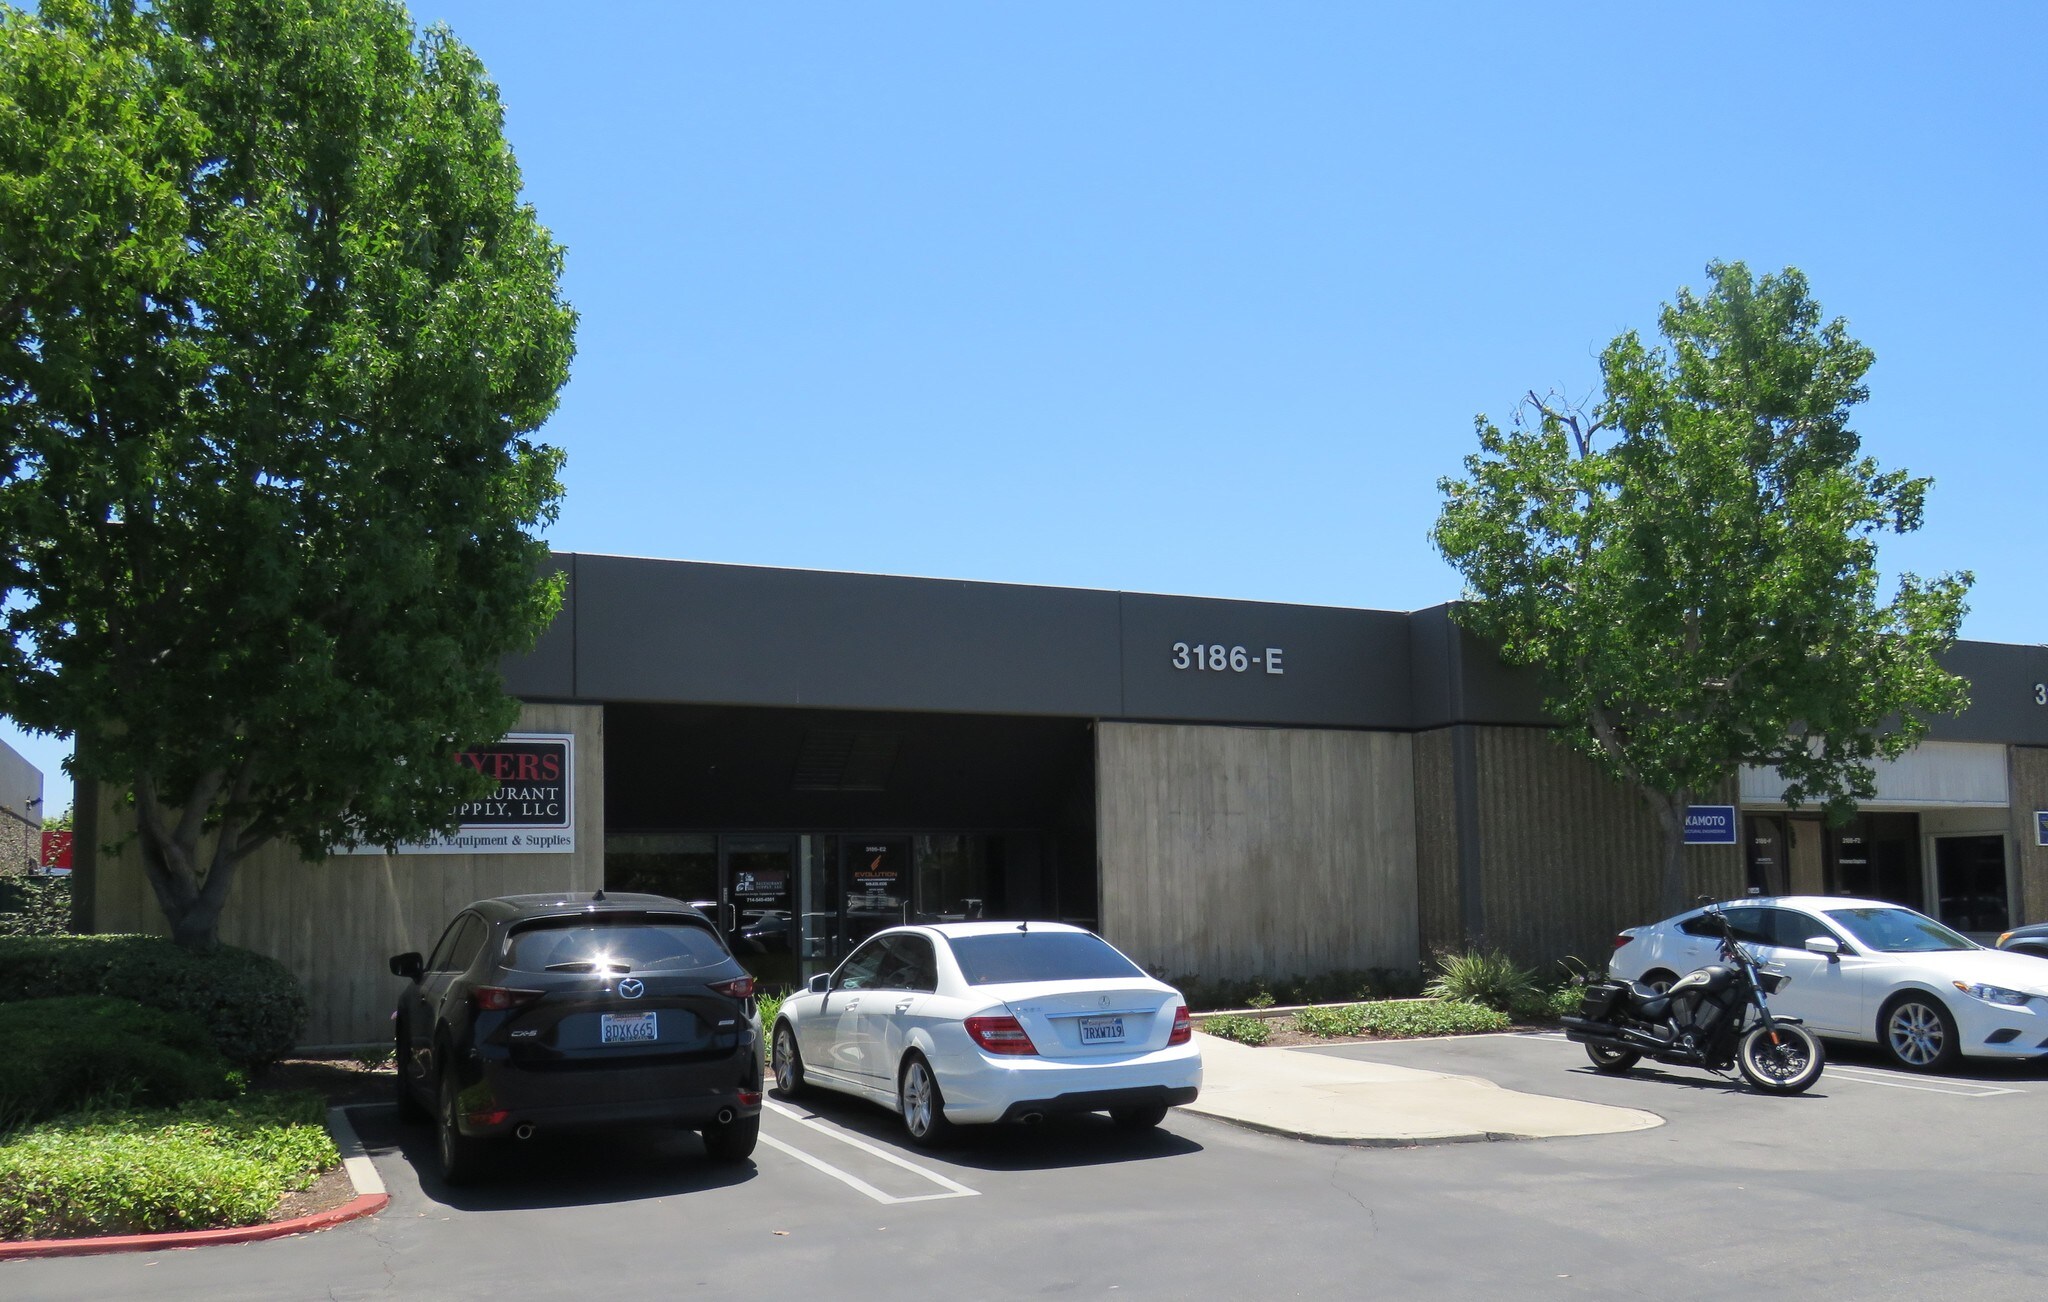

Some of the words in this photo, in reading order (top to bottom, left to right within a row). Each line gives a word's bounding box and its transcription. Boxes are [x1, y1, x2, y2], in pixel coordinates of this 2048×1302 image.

[1173, 642, 1284, 675] 3186-E
[522, 803, 559, 816] LLC
[447, 834, 508, 849] Equipment
[512, 835, 522, 846] &
[526, 834, 571, 849] Supplies
[605, 1022, 653, 1038] 8DXK665
[1083, 1025, 1122, 1039] 7RXW719
